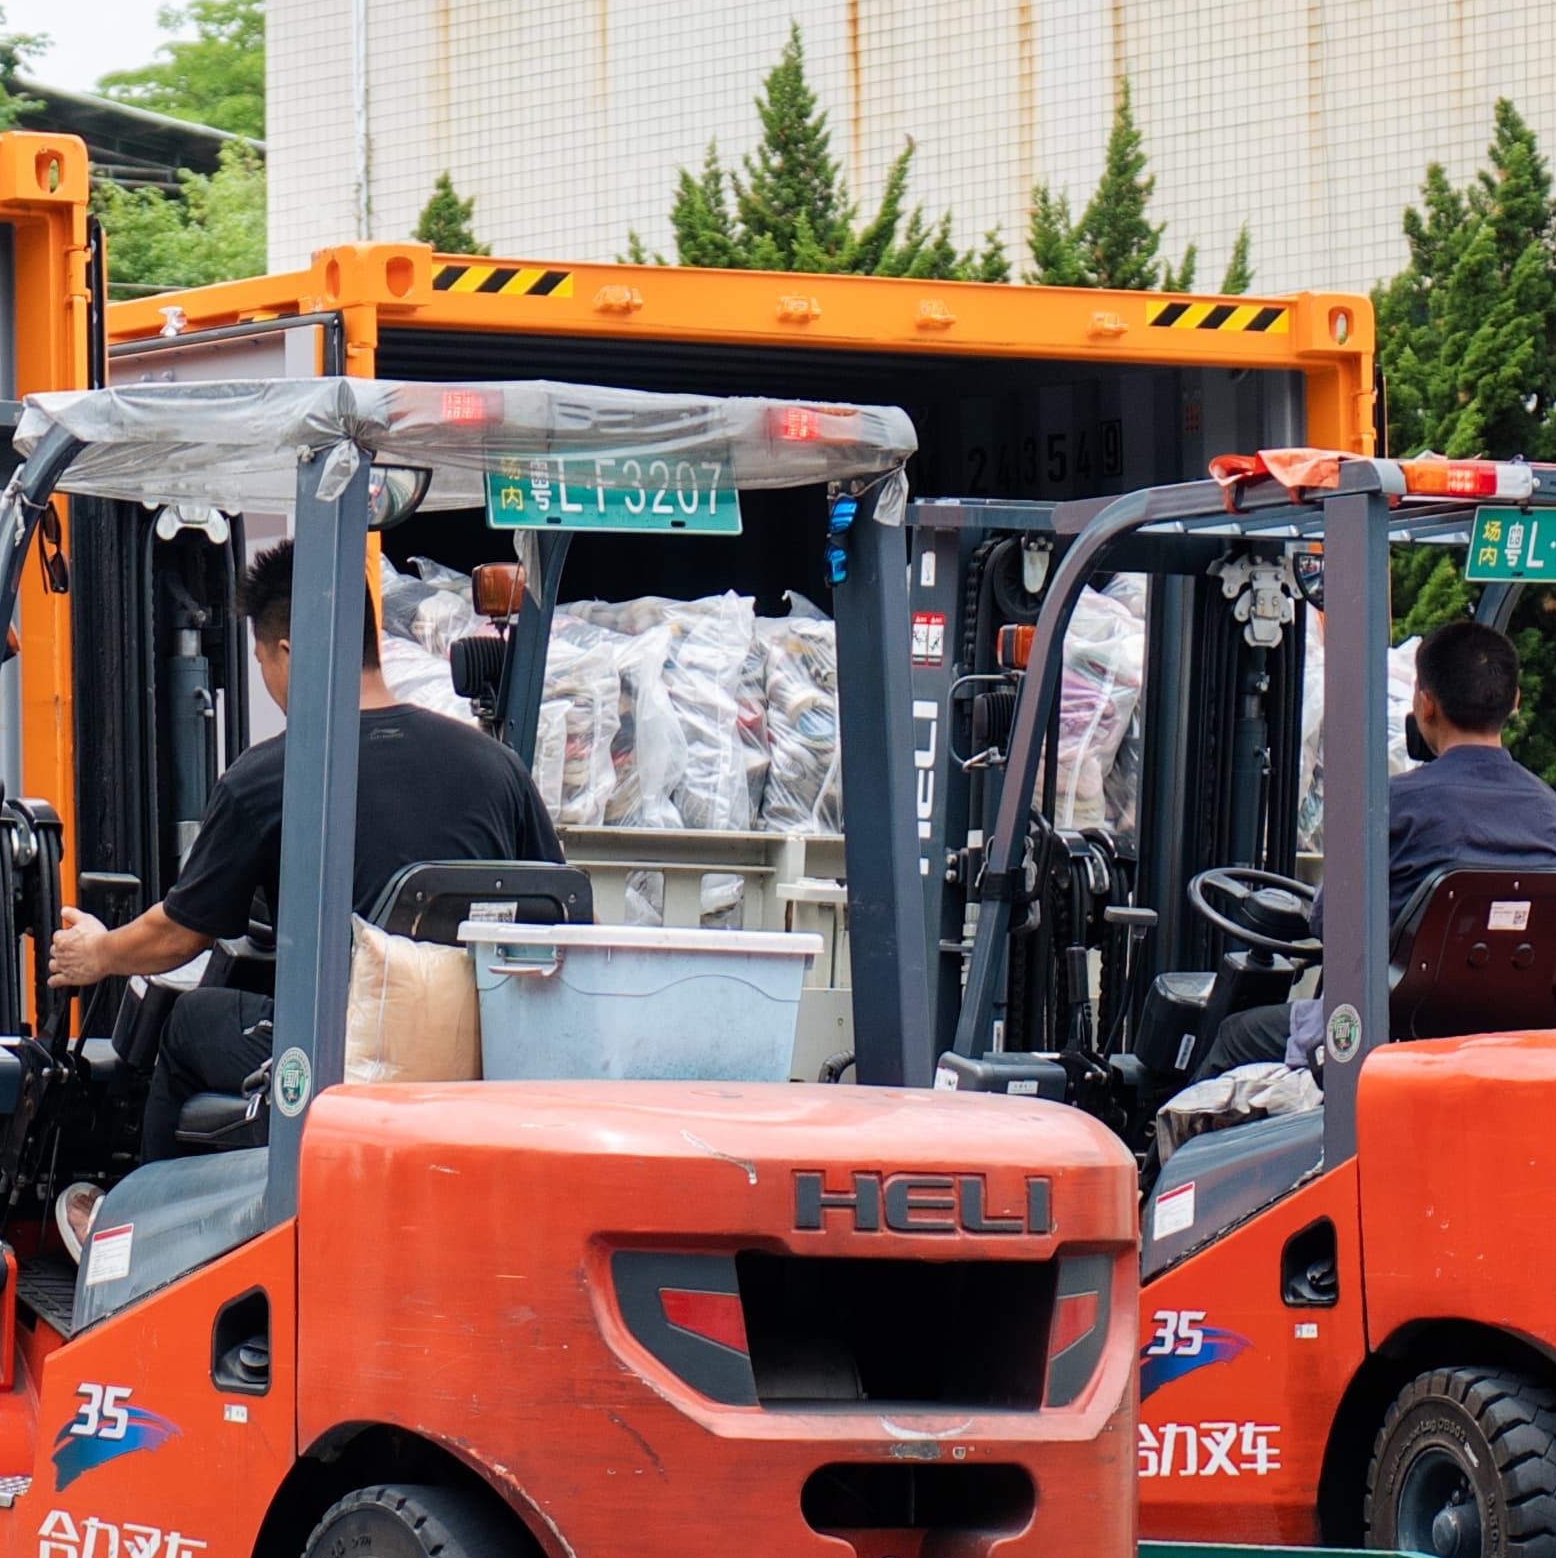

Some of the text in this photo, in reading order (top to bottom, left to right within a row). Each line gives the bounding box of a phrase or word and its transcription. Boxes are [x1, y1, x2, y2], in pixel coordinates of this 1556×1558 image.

[793, 1170, 1051, 1235] HELI
[1151, 1310, 1206, 1356] 35
[70, 1381, 133, 1440] 35
